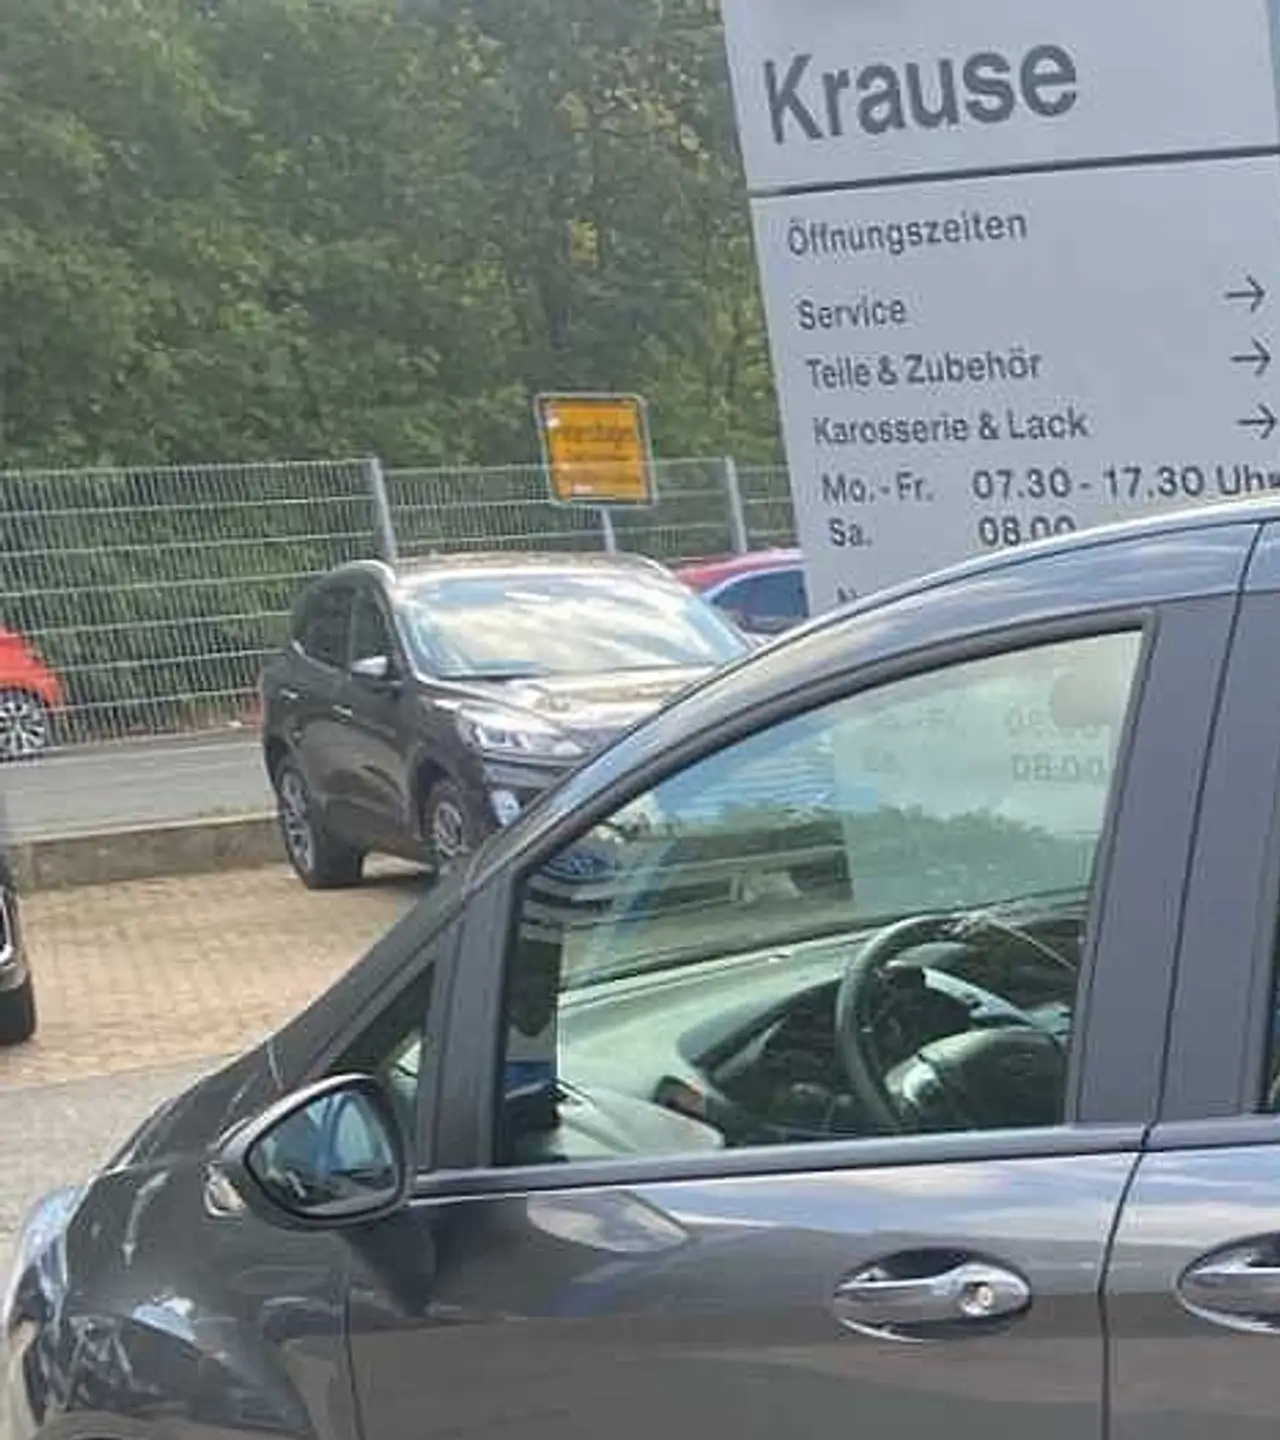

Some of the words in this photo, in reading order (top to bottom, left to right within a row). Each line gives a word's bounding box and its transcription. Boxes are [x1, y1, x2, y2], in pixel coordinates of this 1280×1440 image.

[763, 44, 1077, 146] Krause
[787, 211, 1029, 257] Öffnungszeiten
[798, 294, 907, 330] Service
[806, 355, 871, 389] Teile
[877, 354, 900, 386] &
[903, 346, 1042, 385] Zubehör
[813, 411, 968, 445] Karosserie
[978, 410, 1001, 441] &
[1007, 405, 1089, 441] Lack
[972, 466, 1073, 501] 07.30
[1101, 464, 1206, 498] 17.30
[828, 516, 874, 548] Sa.
